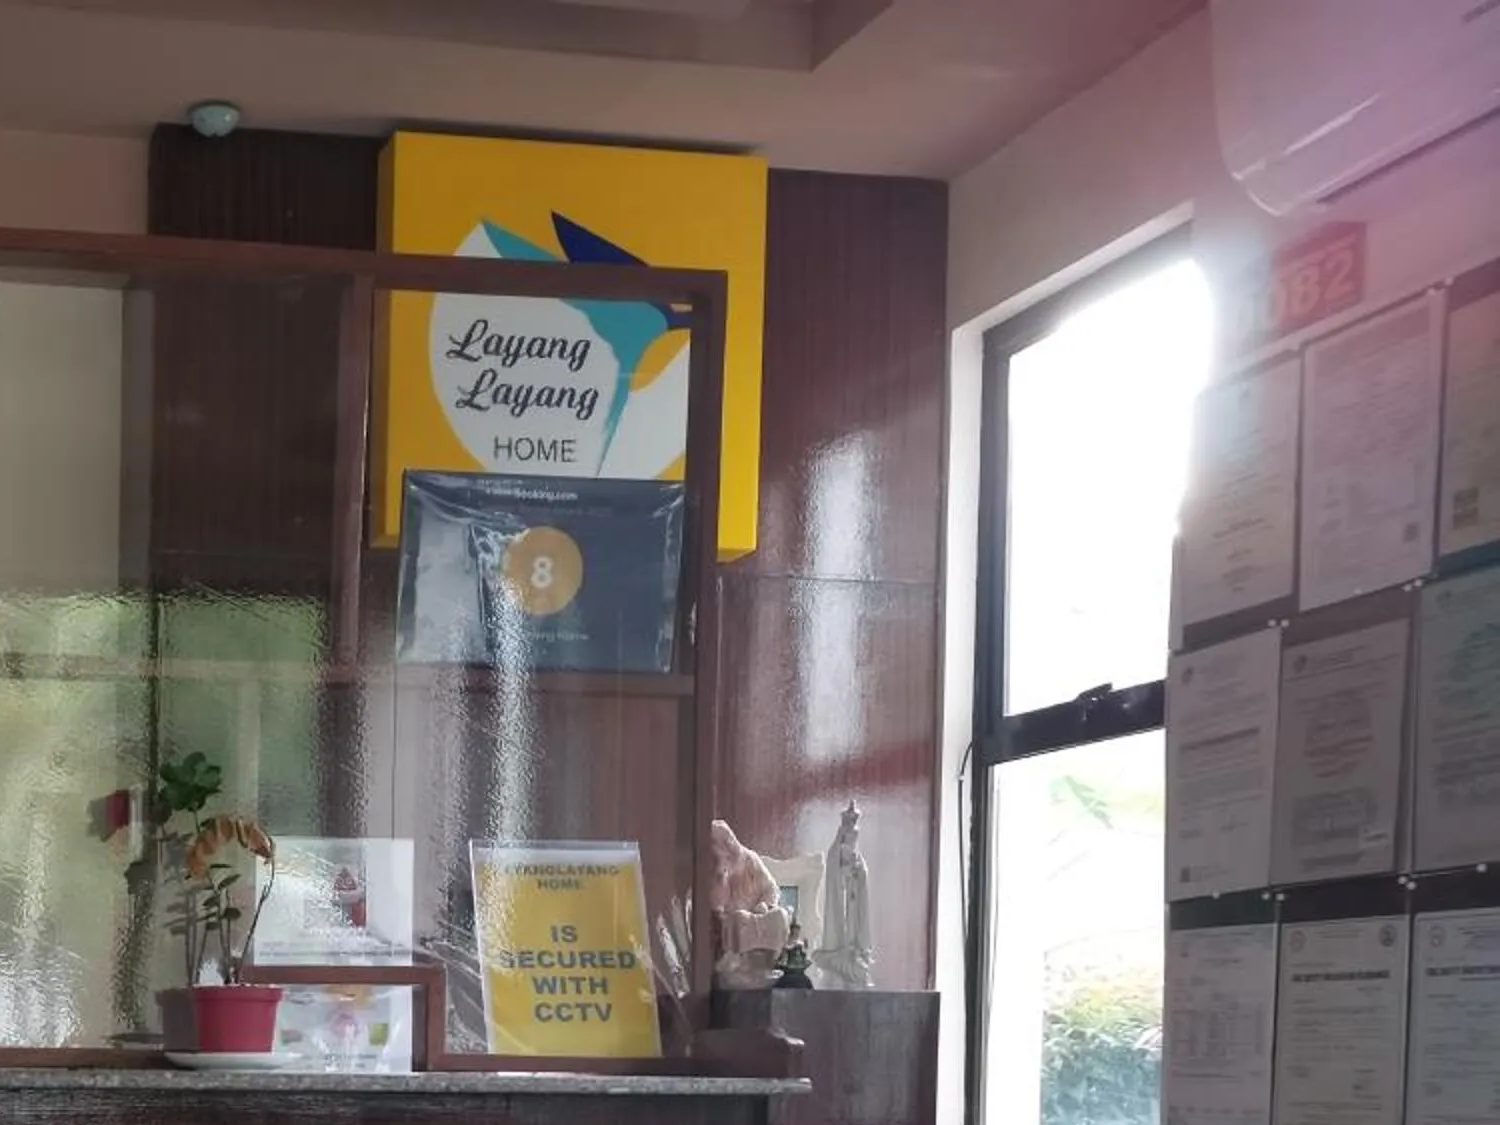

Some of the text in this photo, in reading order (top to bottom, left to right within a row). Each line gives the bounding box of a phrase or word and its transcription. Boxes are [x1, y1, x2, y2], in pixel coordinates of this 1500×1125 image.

[446, 318, 592, 372] Layang
[454, 367, 599, 421] Layang
[492, 435, 579, 463] HOME
[530, 555, 554, 588] 8
[549, 924, 579, 943] IS
[500, 949, 637, 969] SECURED
[532, 976, 609, 995] WITH
[534, 1002, 613, 1023] CCTV
